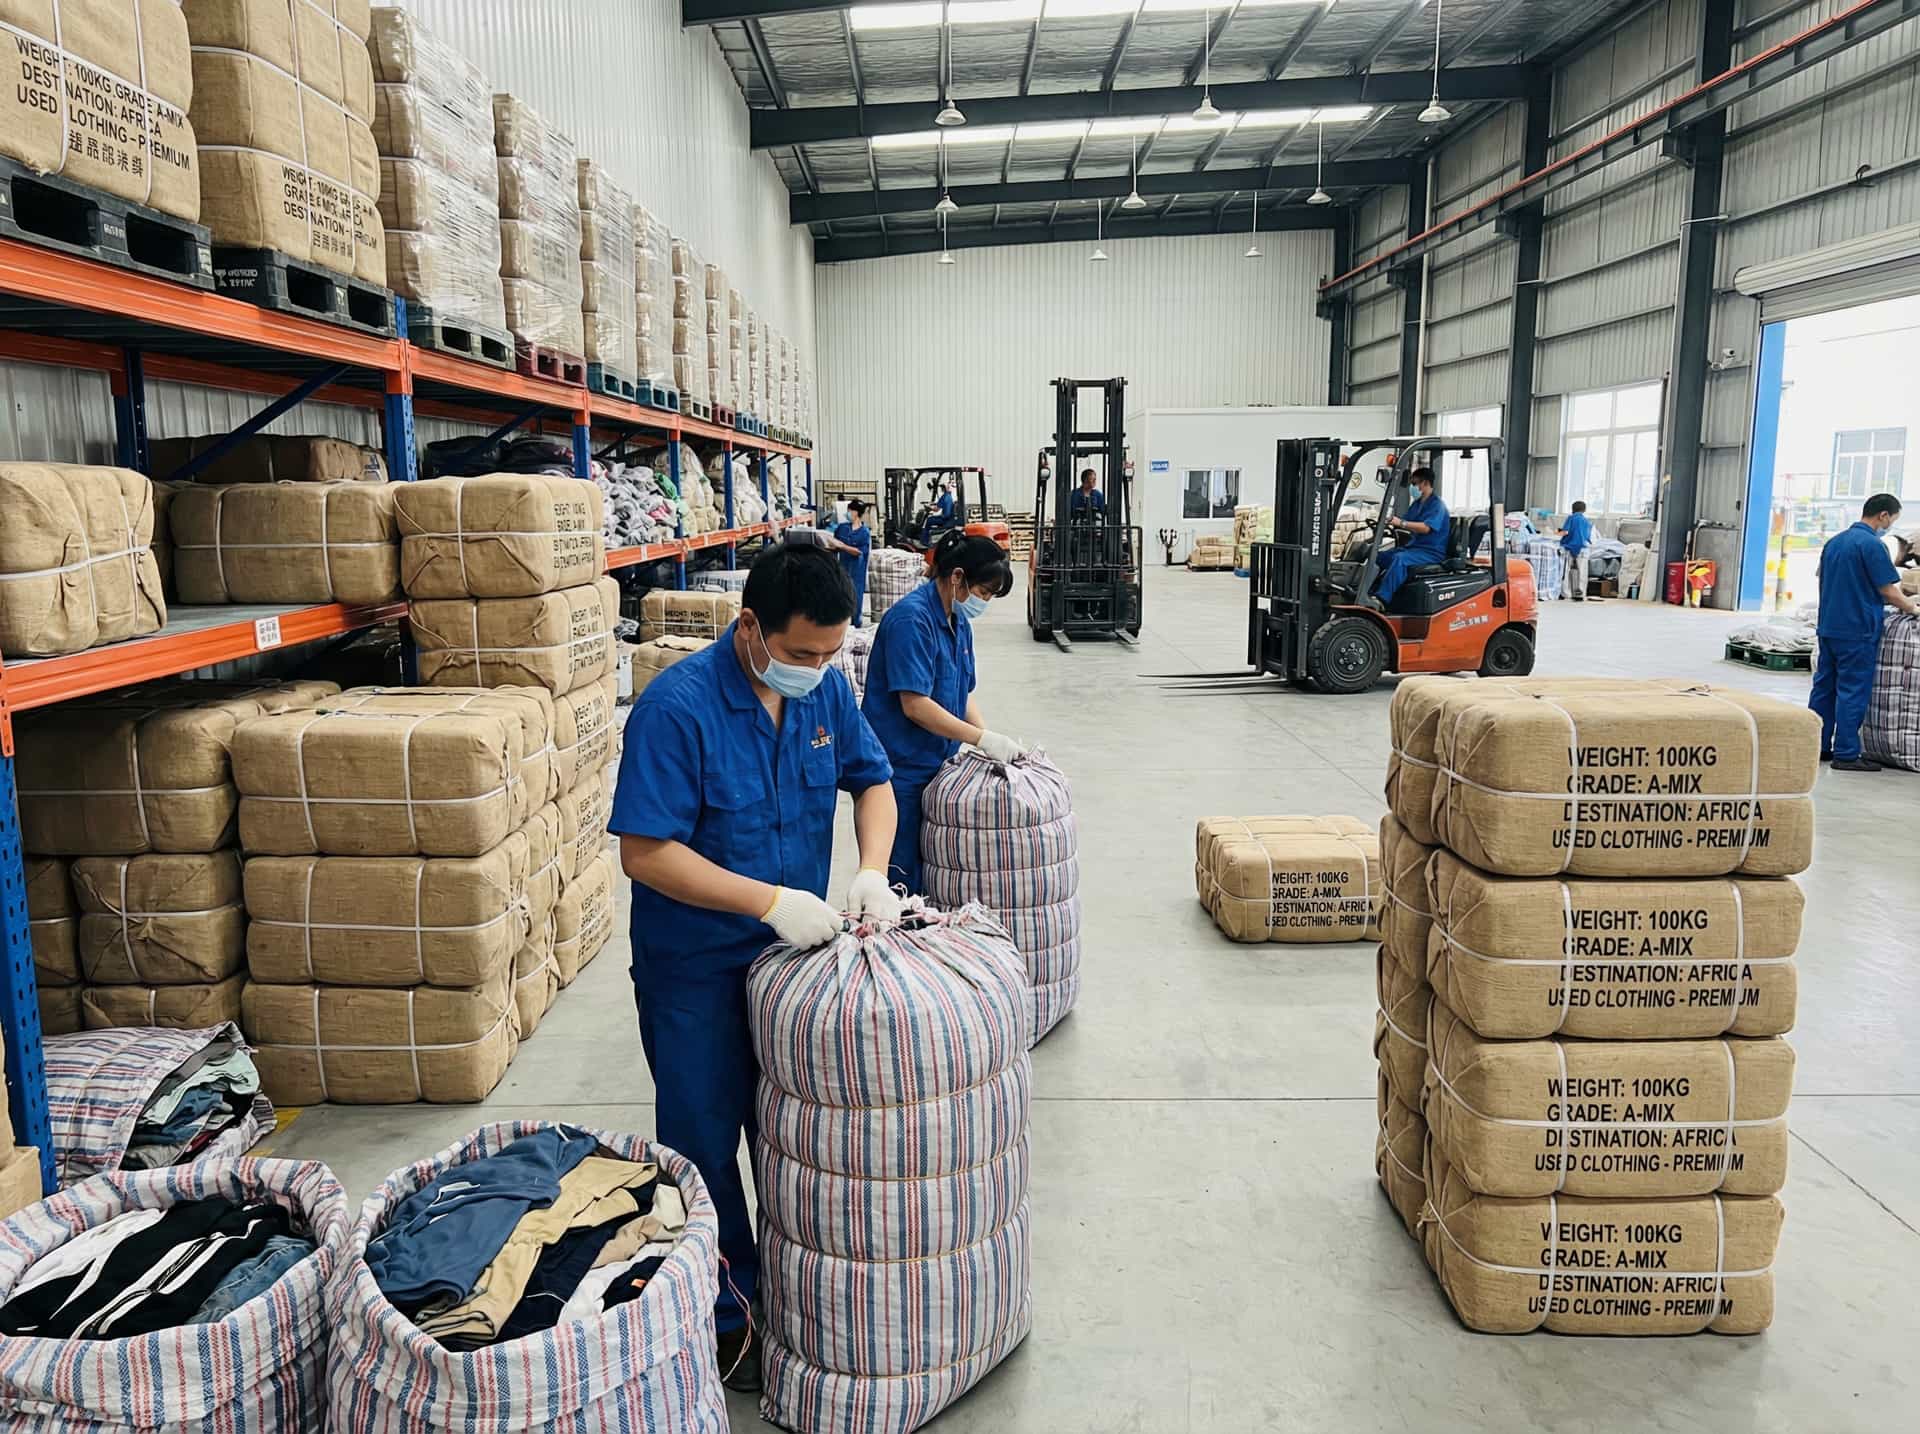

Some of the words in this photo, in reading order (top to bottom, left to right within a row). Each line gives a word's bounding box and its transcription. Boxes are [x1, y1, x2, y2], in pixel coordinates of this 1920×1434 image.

[22, 61, 118, 118] DESTNATION:
[17, 83, 57, 114] USED
[69, 104, 127, 143] LOTHING
[1568, 746, 1649, 767] WEIGHT:
[1656, 746, 1717, 767] 100KG
[1647, 774, 1703, 794] A-MIX
[1564, 802, 1692, 822] DESTINATION:
[1696, 801, 1763, 821] AFRICA
[1552, 829, 1596, 848] USED
[1600, 829, 1683, 848] CLOTHING
[1317, 872, 1349, 884] 100KG
[1312, 887, 1342, 898] A-MIX
[1563, 909, 1642, 930] WEIGHT:
[1649, 909, 1708, 930] 100KG
[1639, 936, 1693, 956] A-MIX
[1688, 964, 1752, 982] AFRICA
[1595, 989, 1676, 1008] CLOTHING
[1547, 1078, 1625, 1097] WEIGHT:
[1632, 1078, 1690, 1097] 100KG
[1547, 1103, 1617, 1122] GRADE:
[1623, 1103, 1675, 1122] A-MIX
[1581, 1154, 1660, 1172] CLOTHING
[1625, 1224, 1682, 1243] 100KG
[1541, 1248, 1611, 1268] GRADE:
[1615, 1250, 1667, 1268] A-MIX
[1539, 1274, 1658, 1293] DESTINATION:
[1528, 1296, 1569, 1314] USED
[1573, 1298, 1651, 1316] CLOTHING
